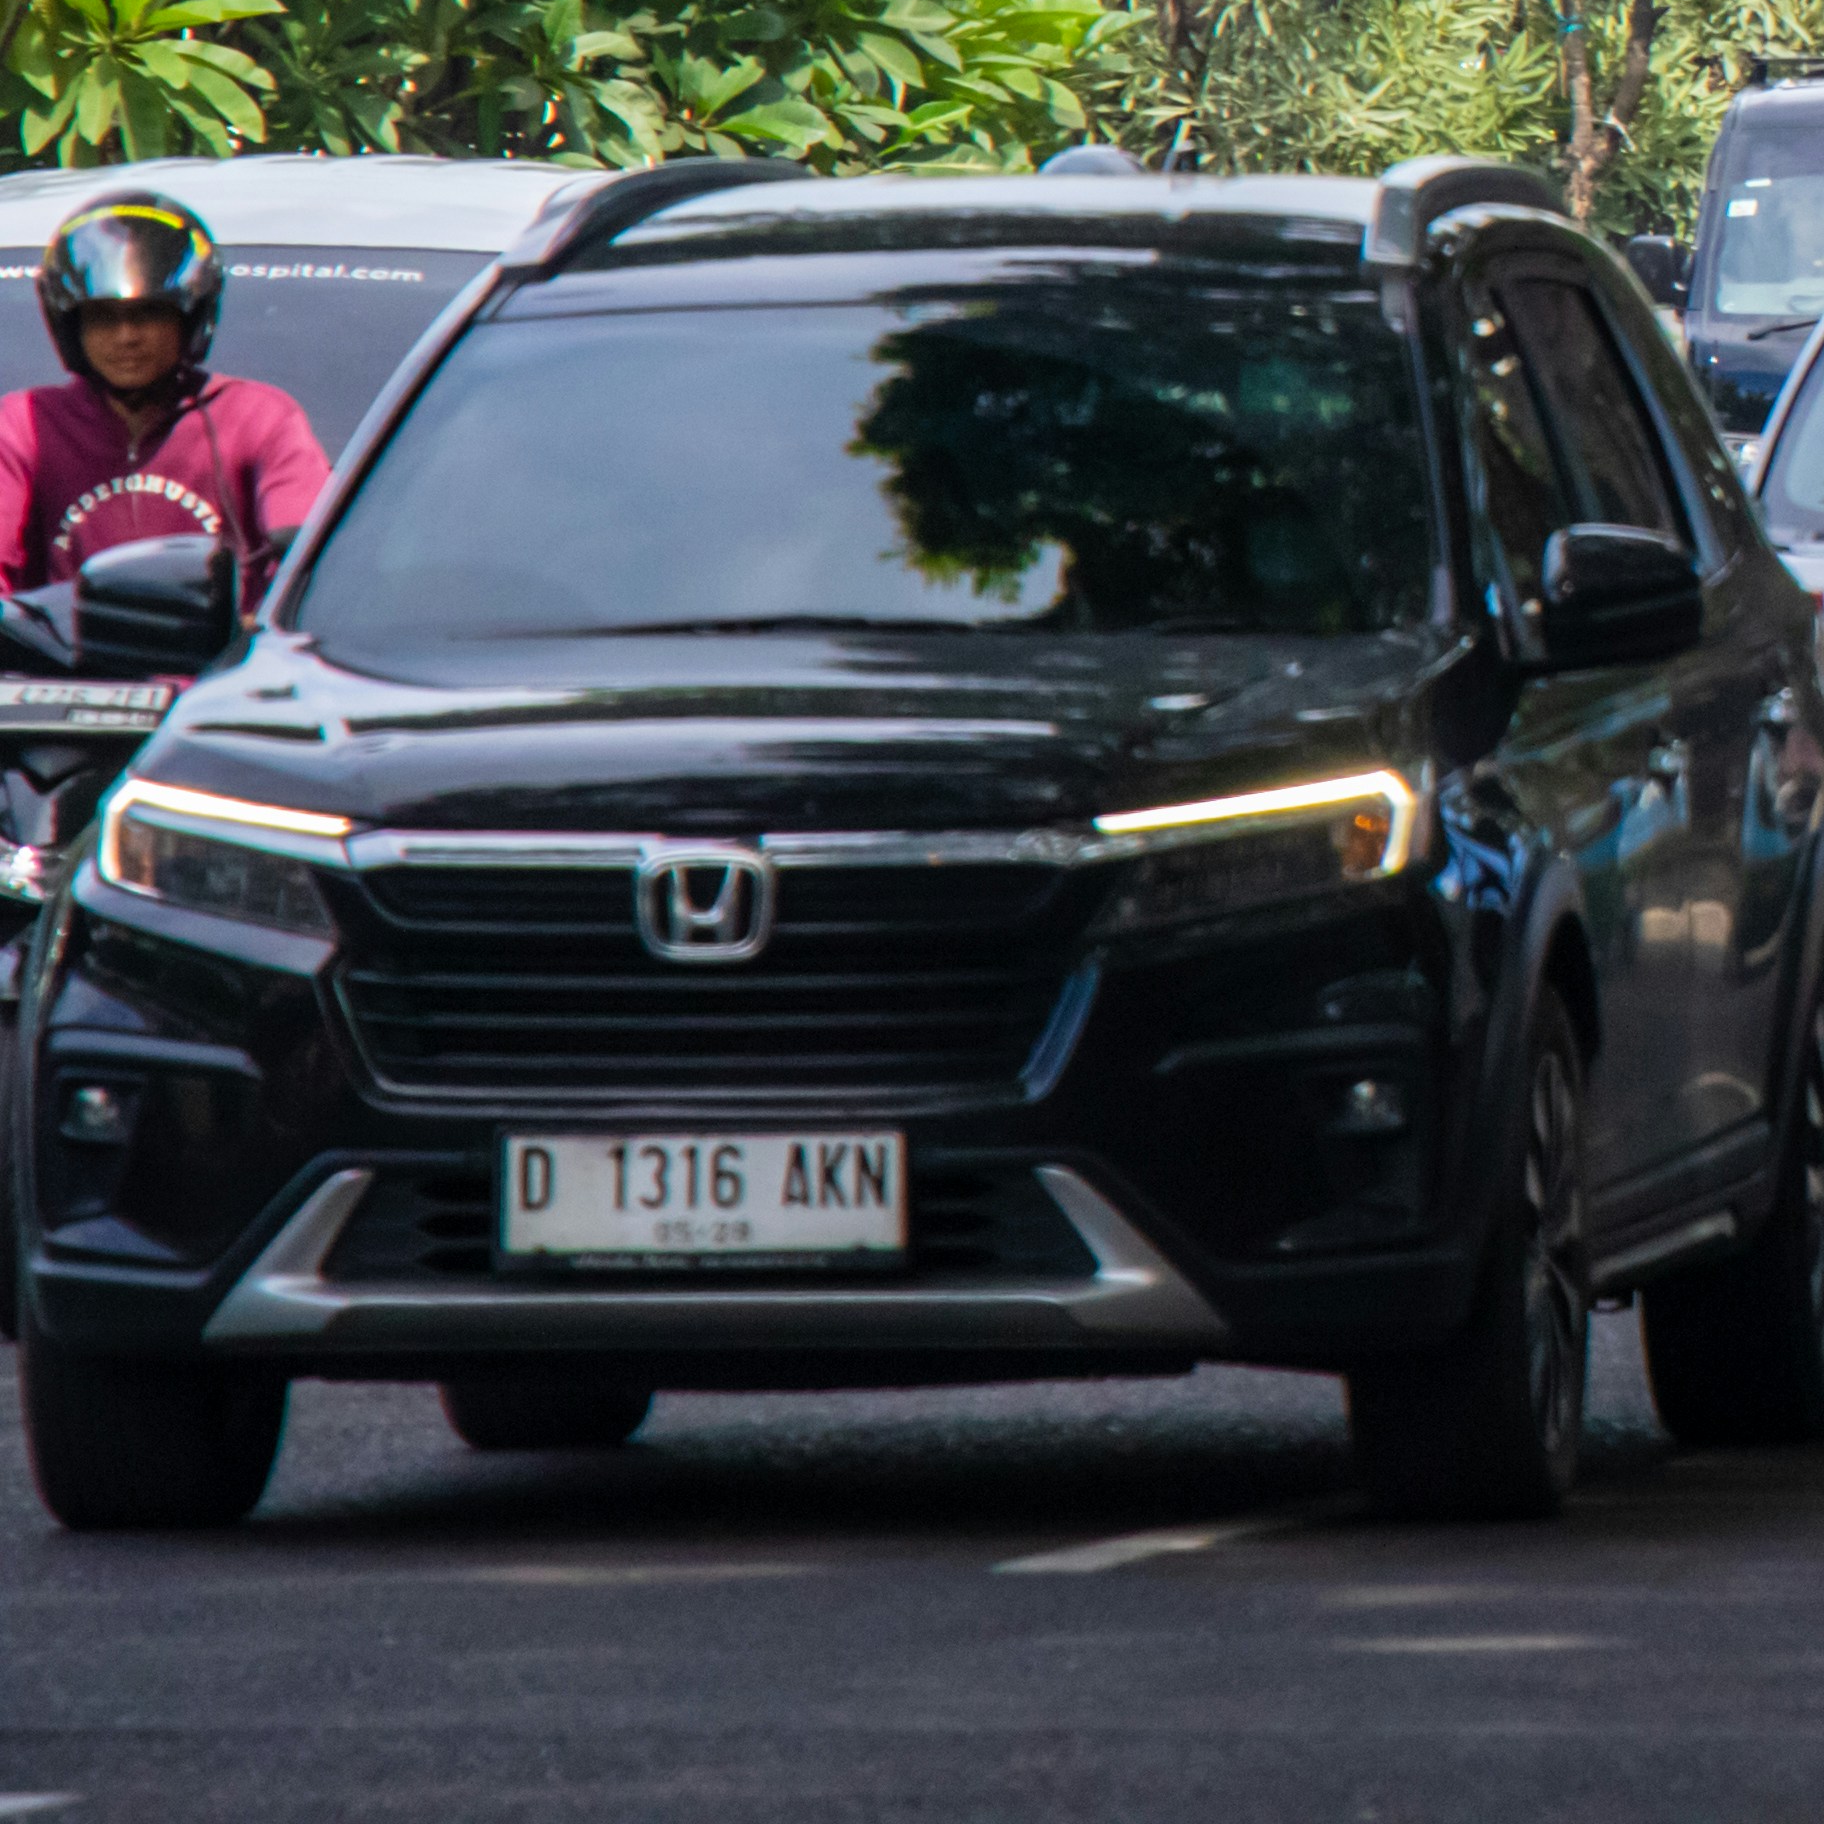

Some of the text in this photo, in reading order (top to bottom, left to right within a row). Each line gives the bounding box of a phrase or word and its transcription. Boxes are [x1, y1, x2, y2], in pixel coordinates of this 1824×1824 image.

[517, 1141, 890, 1212] D 1316 AKN
